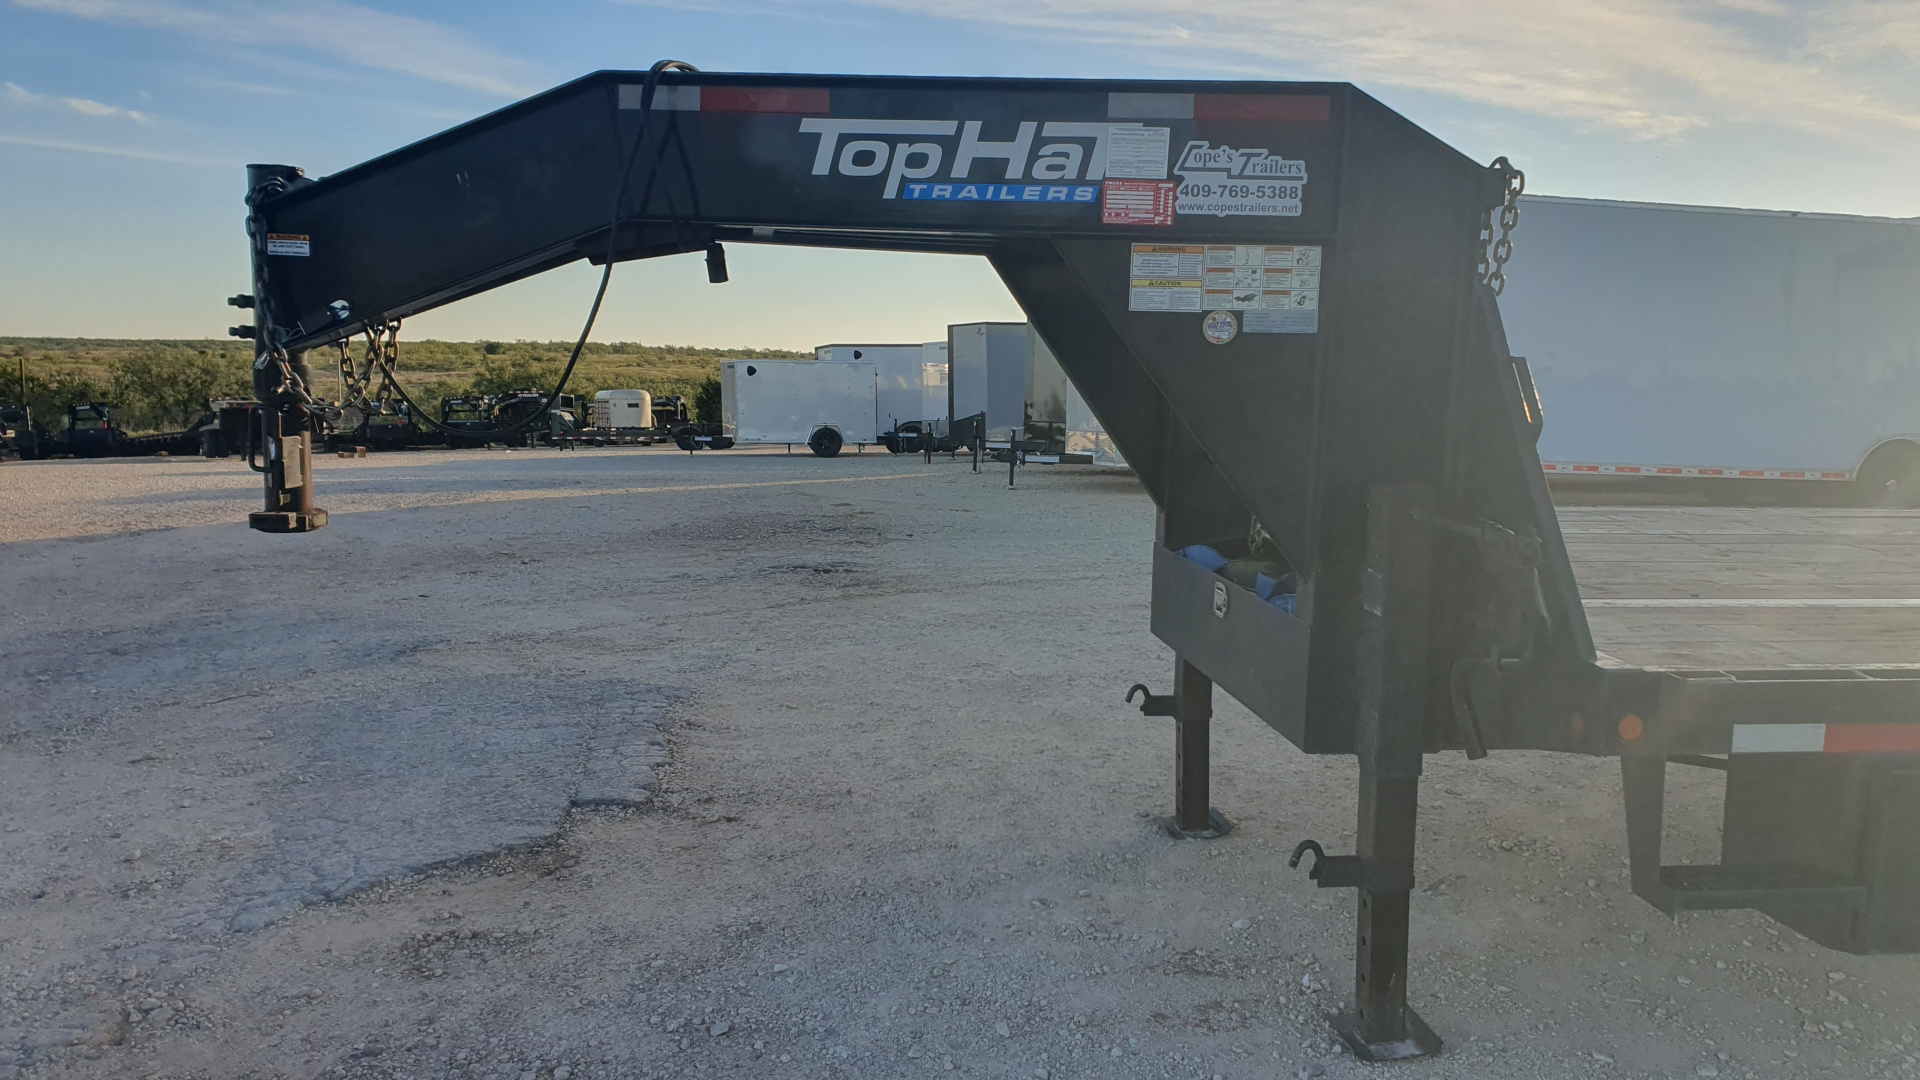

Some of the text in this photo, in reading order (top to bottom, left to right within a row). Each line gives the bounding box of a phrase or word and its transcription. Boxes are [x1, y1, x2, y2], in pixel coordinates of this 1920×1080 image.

[1177, 144, 1233, 172] Cope's
[1237, 153, 1303, 177] Trailers
[909, 184, 1093, 201] TRAILERS
[1180, 184, 1299, 199] 409-769-5388
[1178, 203, 1298, 213] www.copestrailers.net
